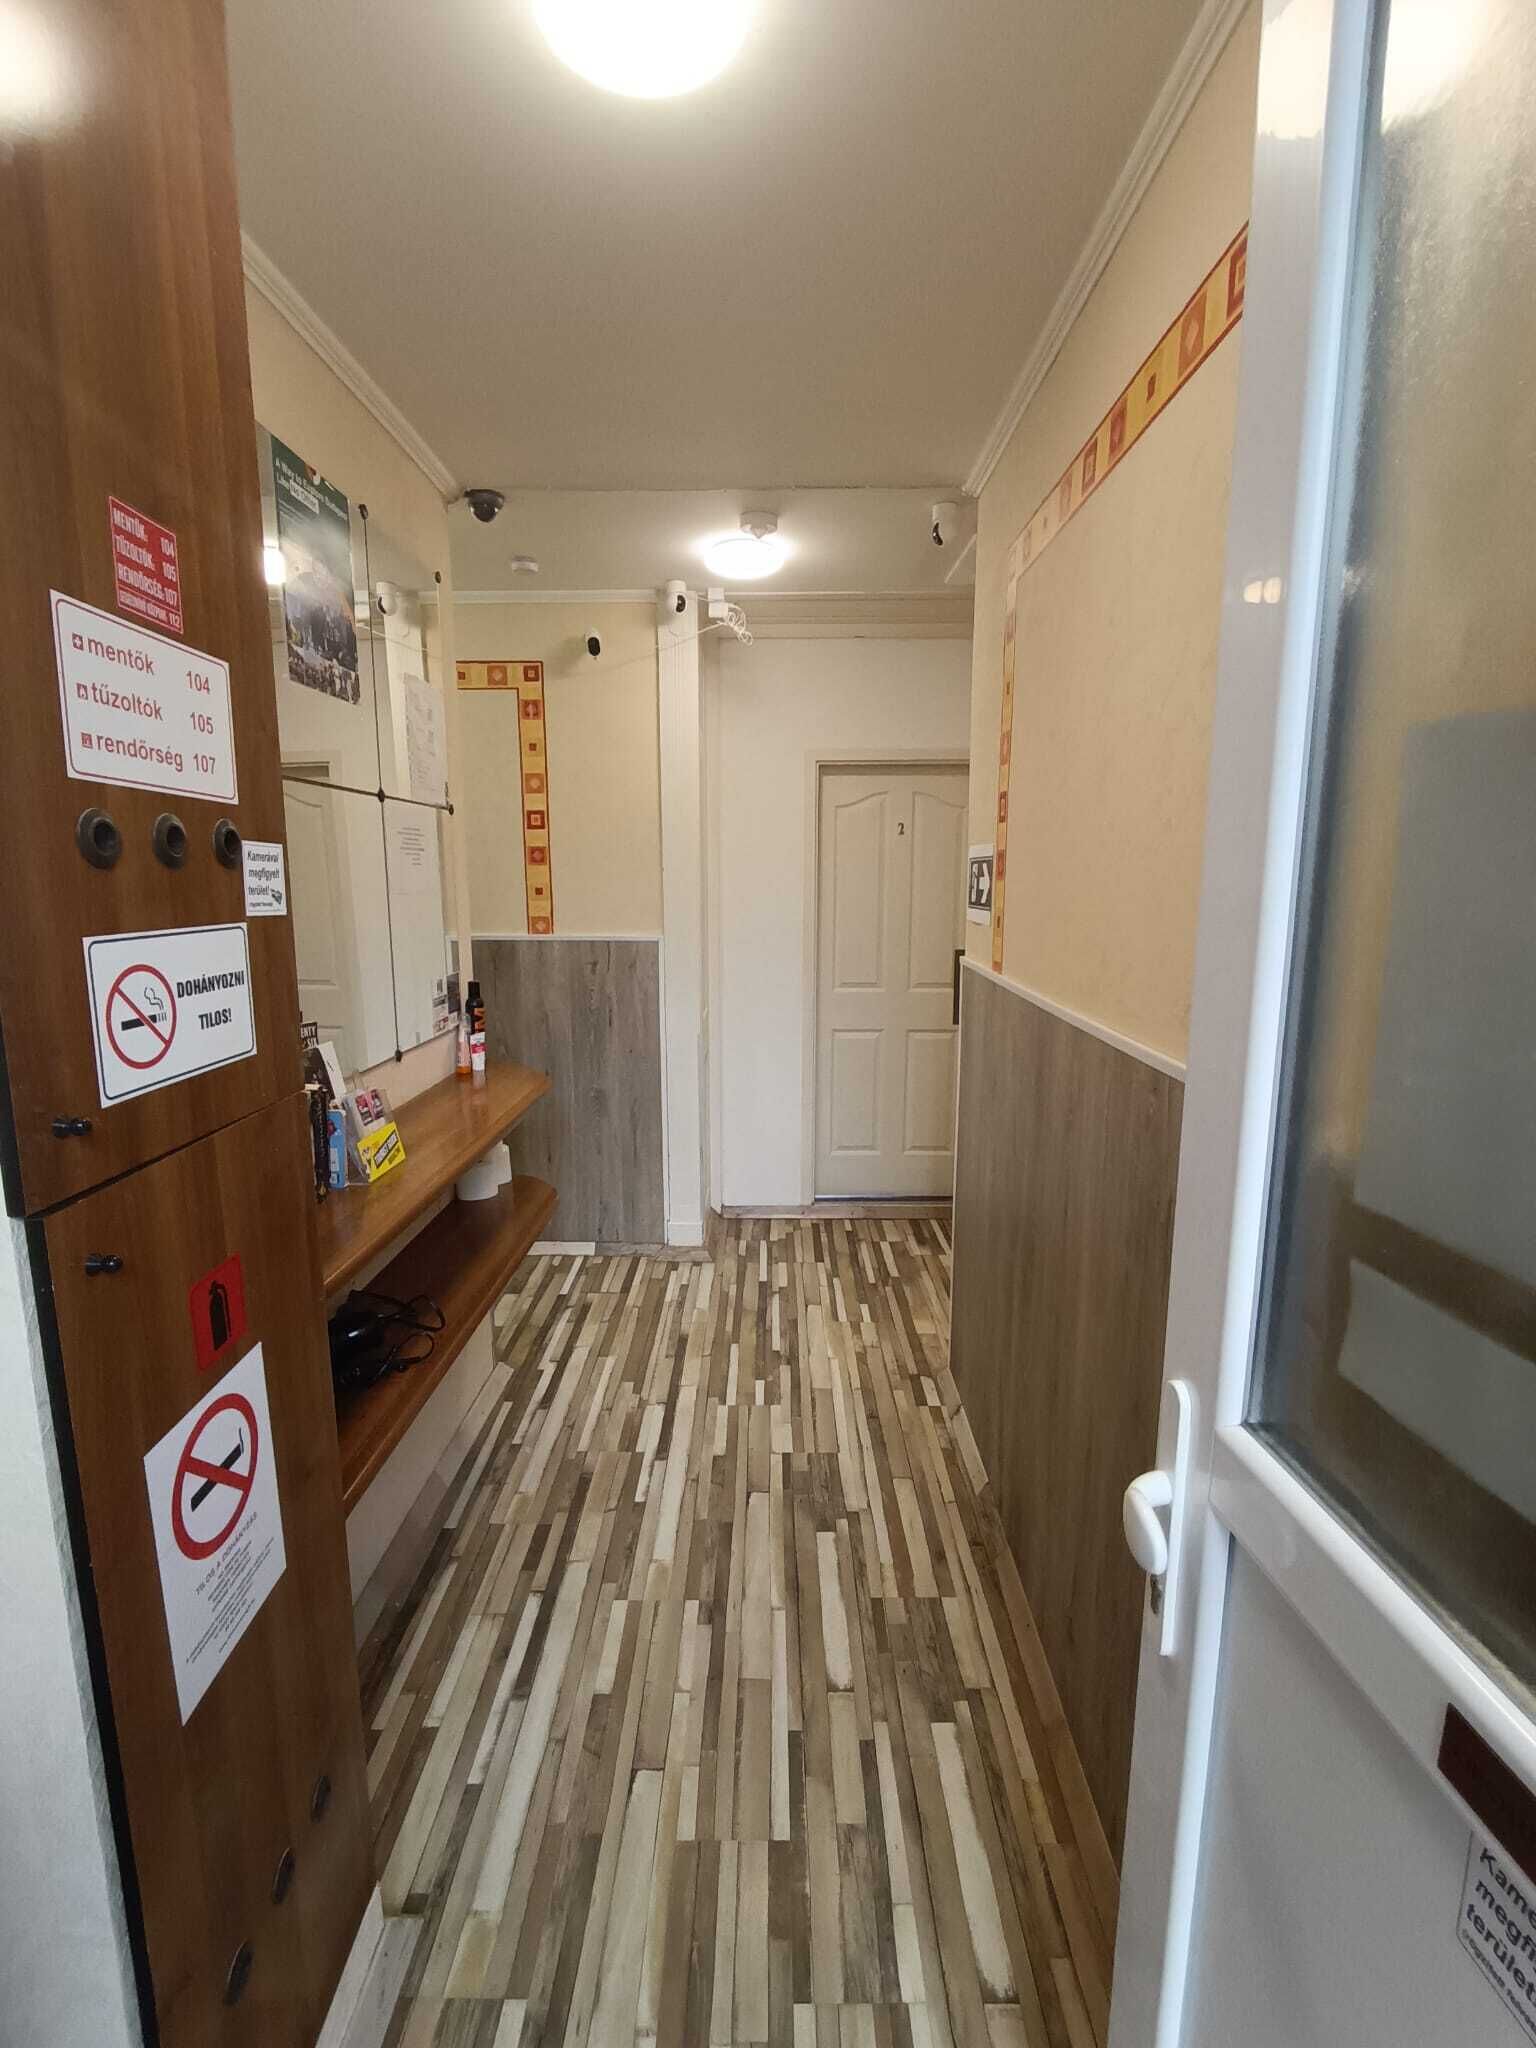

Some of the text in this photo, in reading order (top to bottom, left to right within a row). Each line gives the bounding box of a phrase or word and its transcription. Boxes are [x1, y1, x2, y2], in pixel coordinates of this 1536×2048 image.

[160, 537, 175, 560] 104
[87, 637, 211, 695] mentők 104
[91, 681, 214, 735] tűzoltók 105
[96, 734, 216, 775] rendőrség 107
[897, 822, 905, 836] 2
[176, 970, 245, 999] DOHÁNYOZNI
[198, 1007, 232, 1030] TILOS!
